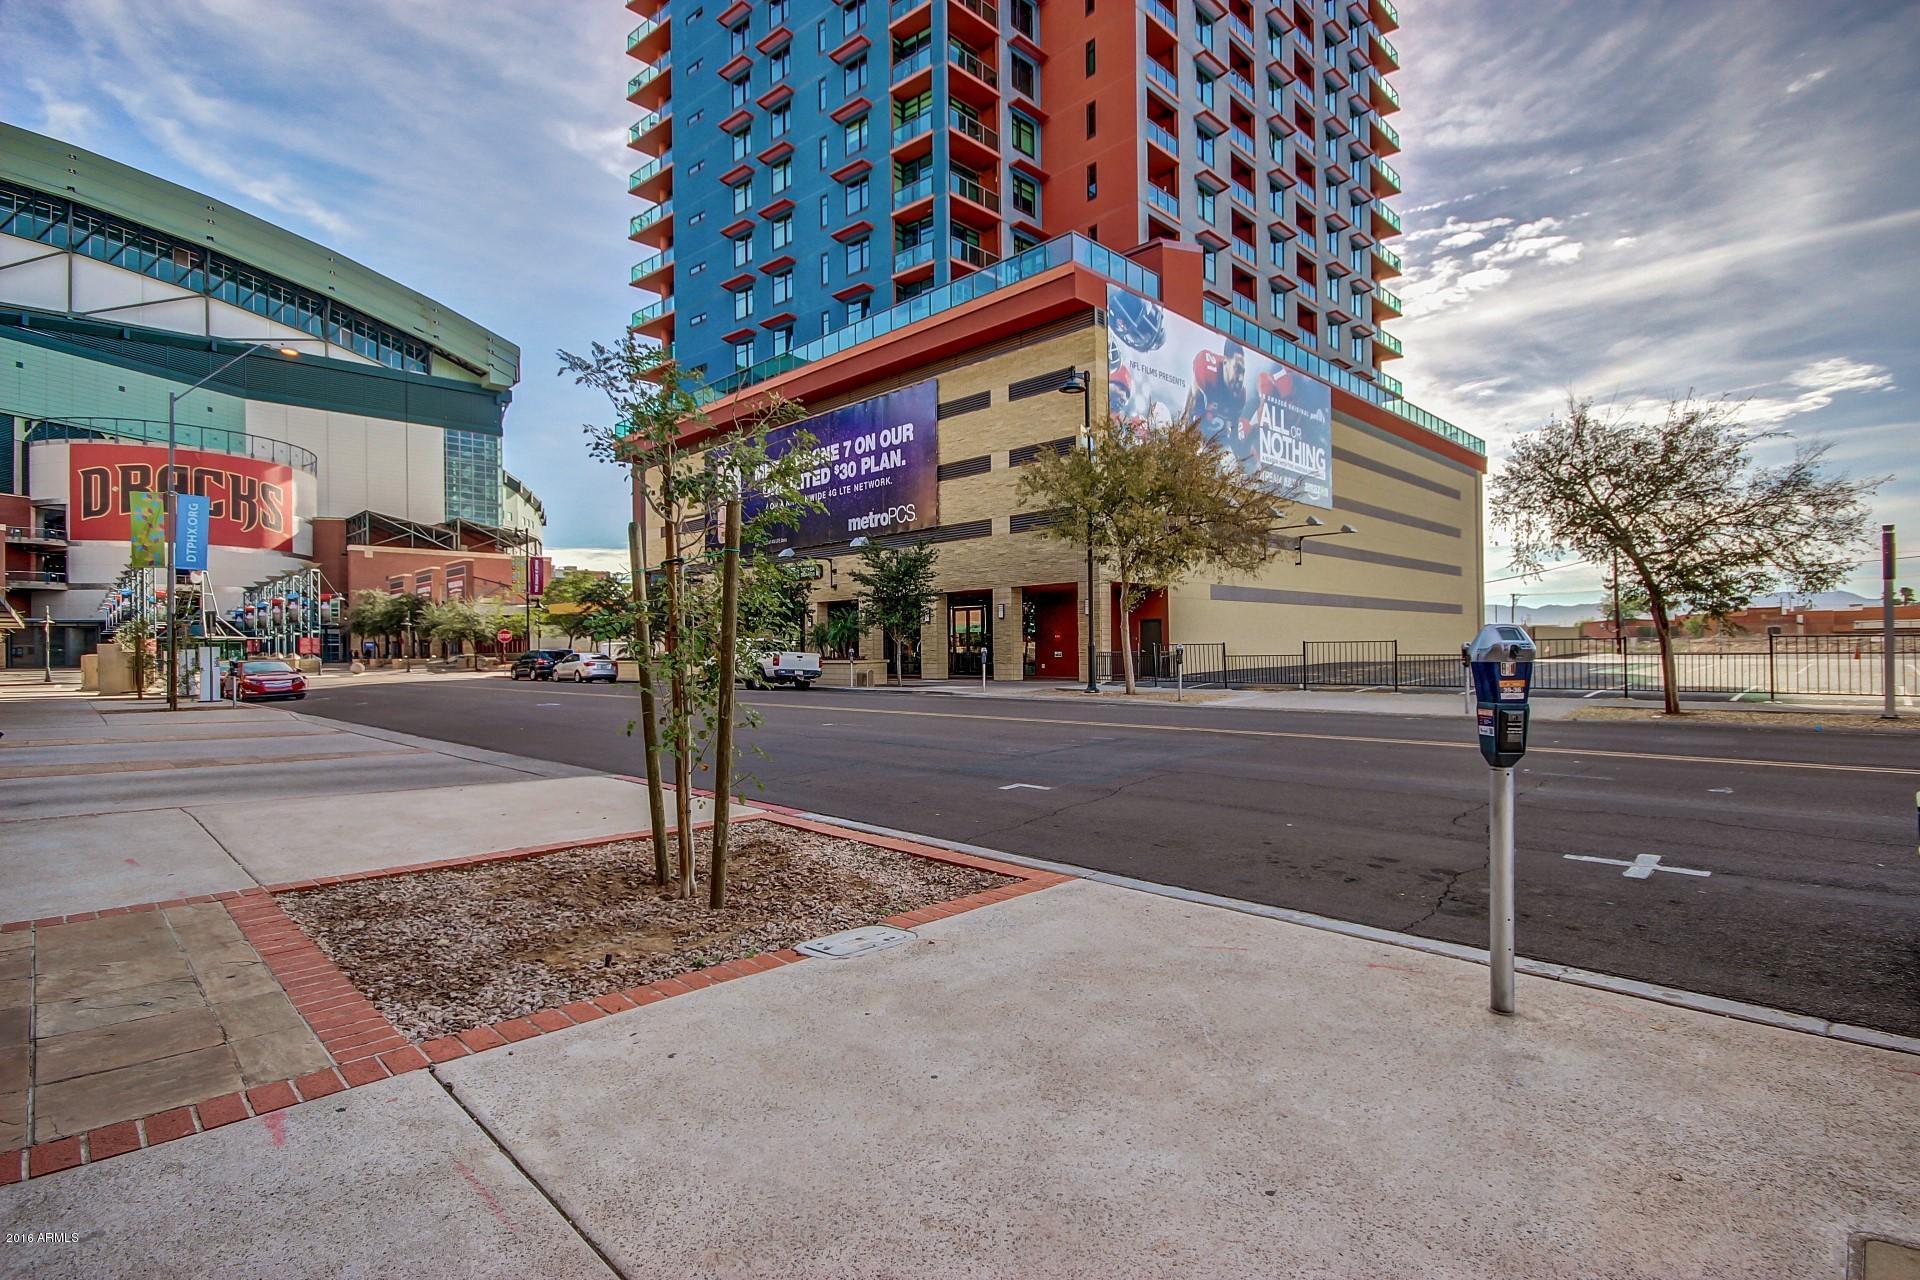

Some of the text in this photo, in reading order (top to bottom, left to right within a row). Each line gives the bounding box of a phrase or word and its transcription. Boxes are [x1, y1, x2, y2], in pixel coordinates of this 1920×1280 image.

[1129, 360, 1186, 388] NFL FILMS PRESENTS
[1260, 402, 1290, 436] ALL
[1290, 425, 1302, 440] OR
[843, 440, 852, 458] 7
[854, 432, 876, 455] ON
[880, 422, 914, 448] OUR
[1260, 427, 1326, 471] NOTHING
[834, 461, 857, 480] $30
[861, 448, 906, 476] PLAN.
[828, 488, 837, 497] 4G
[839, 485, 851, 496] LTE
[853, 476, 893, 492] NETWORK.
[186, 503, 199, 562] DTPHX.ORG
